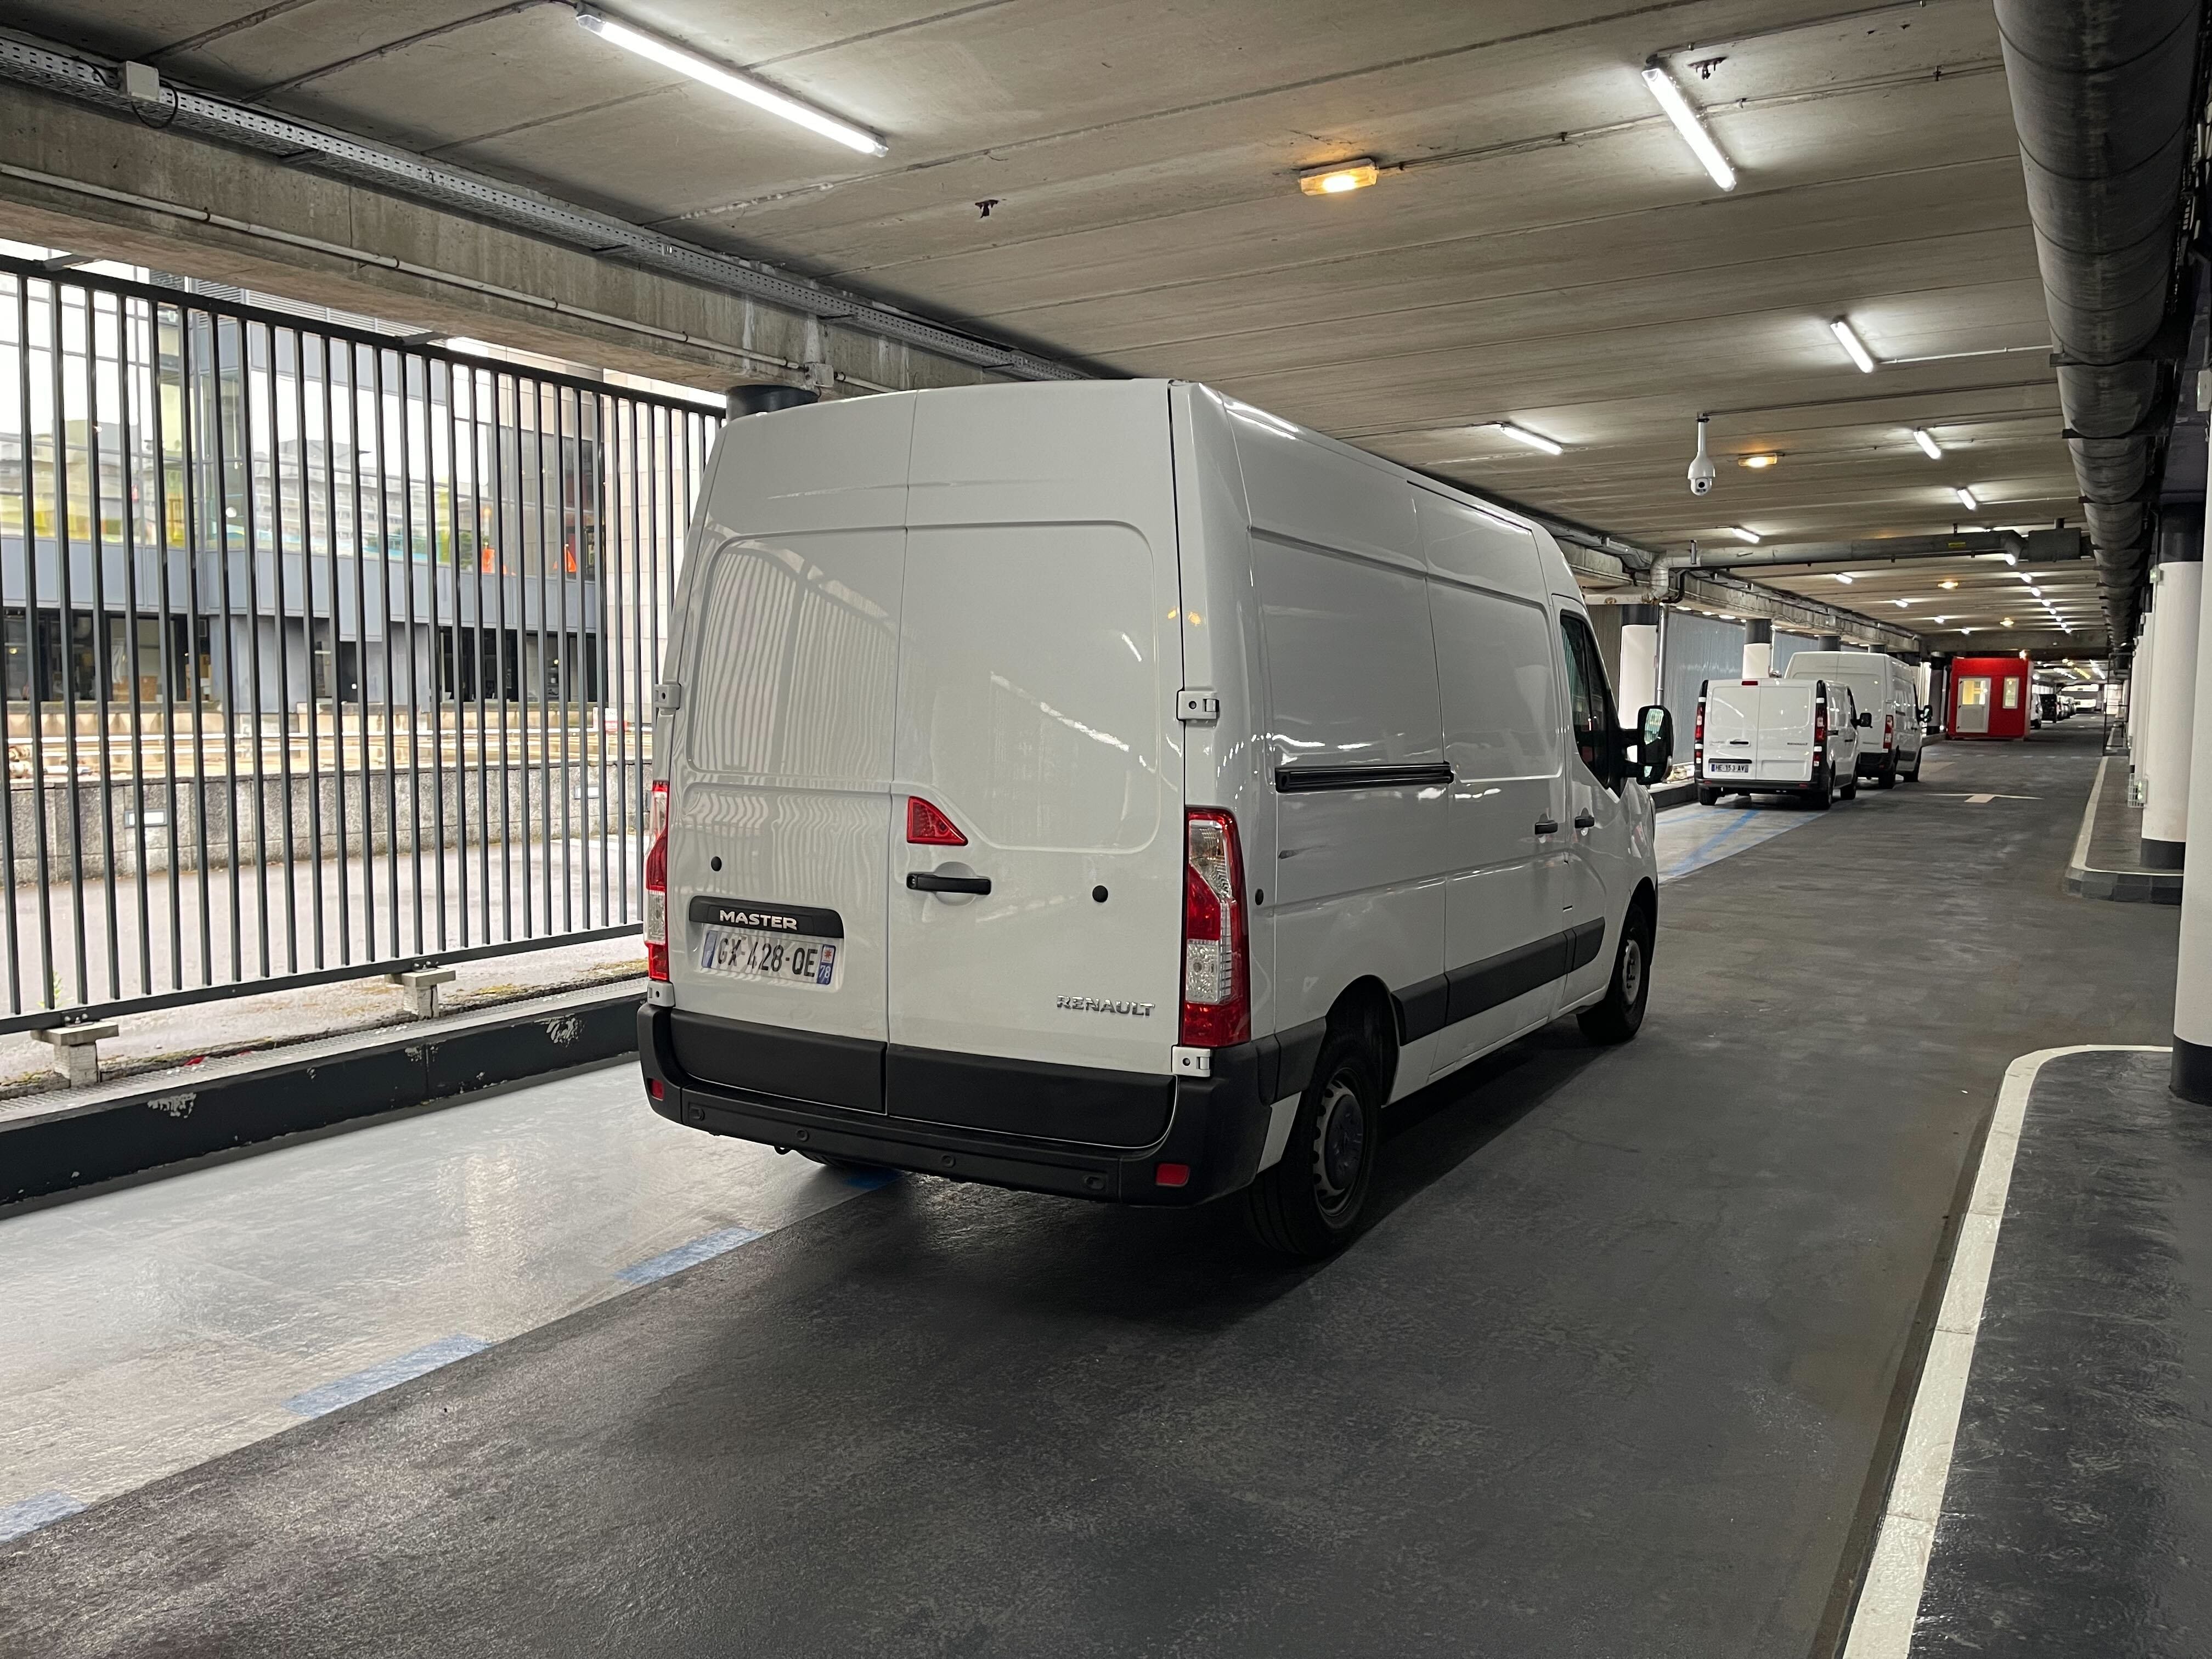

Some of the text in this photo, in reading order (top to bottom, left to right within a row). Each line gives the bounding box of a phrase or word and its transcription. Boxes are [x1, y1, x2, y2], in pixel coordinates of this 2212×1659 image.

[720, 910, 797, 930] MASTER
[819, 965, 831, 978] 78
[1057, 995, 1155, 1016] RENAULT
